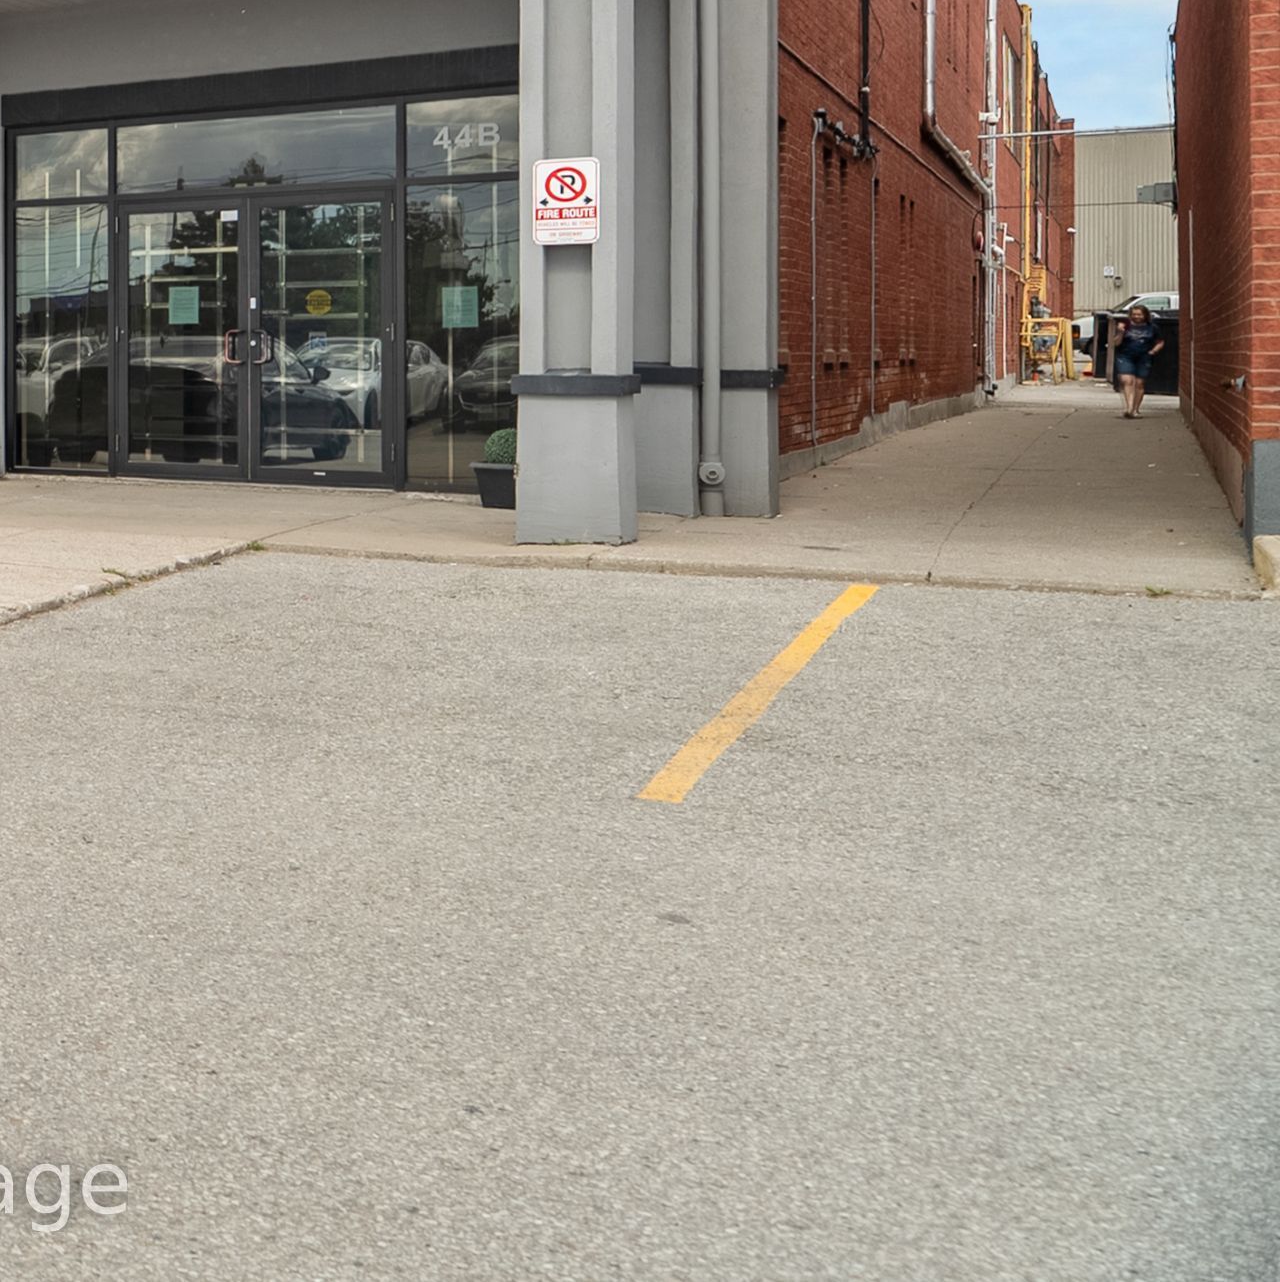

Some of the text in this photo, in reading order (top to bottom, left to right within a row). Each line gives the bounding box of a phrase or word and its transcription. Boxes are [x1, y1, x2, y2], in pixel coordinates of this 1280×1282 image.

[432, 122, 501, 150] 44B
[537, 206, 596, 220] FIRE ROUTE
